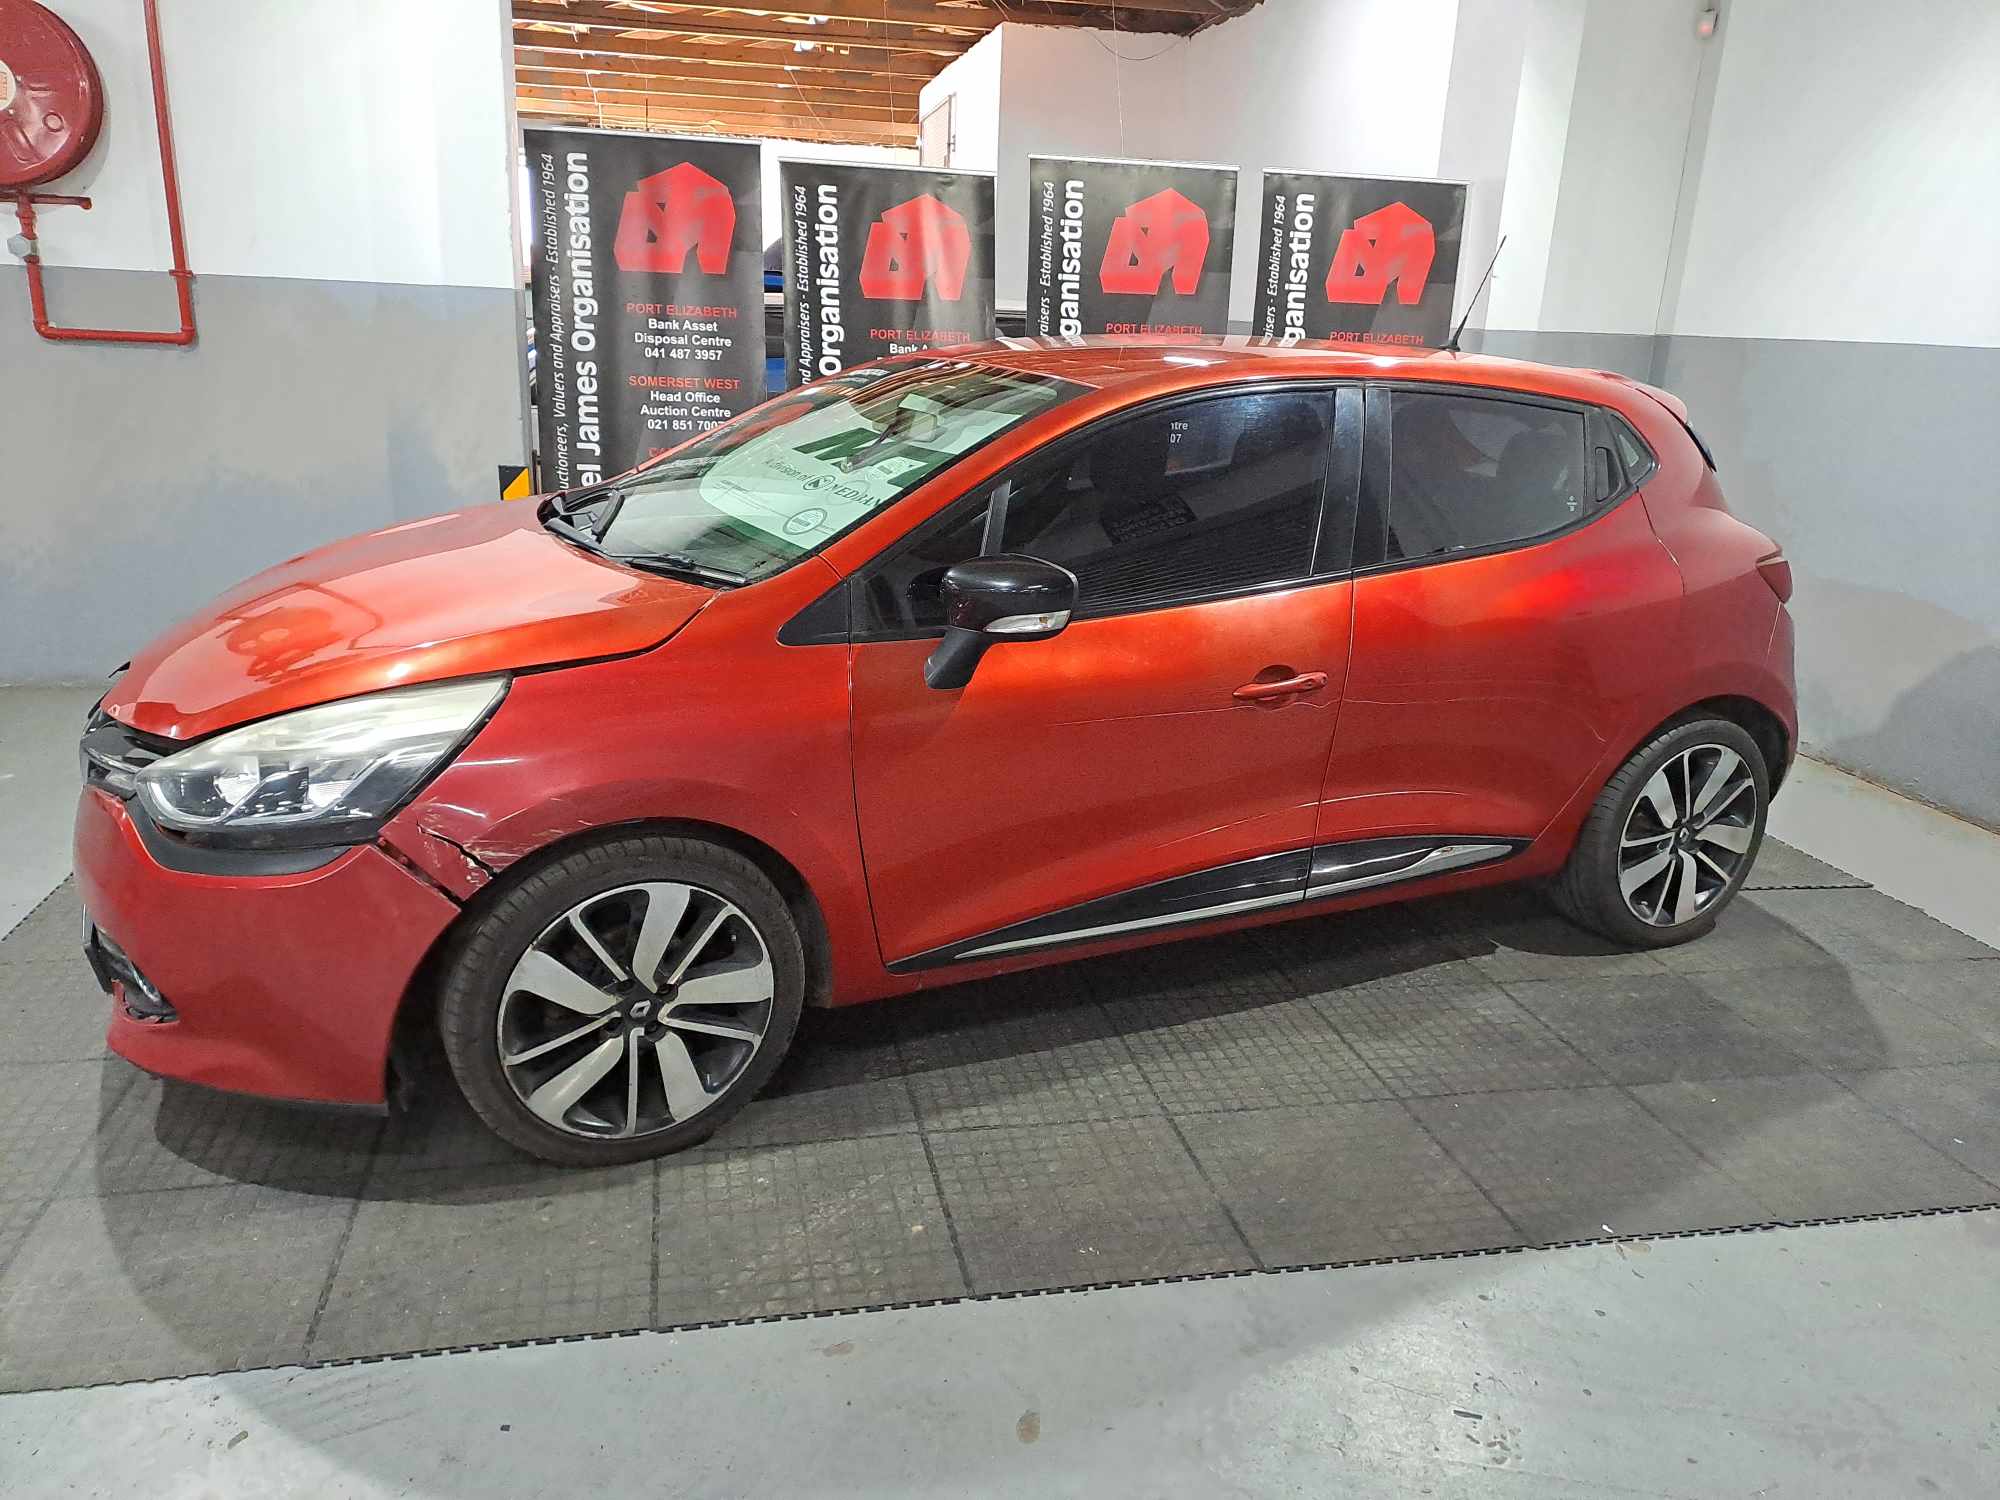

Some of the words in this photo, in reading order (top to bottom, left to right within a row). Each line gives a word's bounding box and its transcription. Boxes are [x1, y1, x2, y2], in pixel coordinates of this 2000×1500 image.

[541, 153, 555, 186] 1964
[794, 185, 808, 216] 1964
[1041, 181, 1056, 213] 1964
[1273, 194, 1287, 226] 1964
[542, 189, 559, 264] Established
[564, 152, 599, 352] Organisation
[794, 218, 809, 292] Established
[1039, 215, 1054, 287] Established
[1266, 227, 1284, 296] Established
[815, 184, 845, 376] Organisation
[547, 274, 565, 342] Appraisers
[626, 302, 662, 315] PORT
[666, 304, 737, 319] ELIZABETH
[634, 332, 688, 346] Disposal
[692, 334, 732, 347] Centre
[648, 318, 680, 330] Bank
[682, 319, 718, 332] Asset
[799, 301, 814, 368] Appraisers
[869, 328, 903, 340] PORT
[1105, 322, 1137, 334] PORT
[1329, 331, 1361, 342] PORT
[1363, 332, 1425, 345] ELIZABETH
[549, 344, 564, 368] and
[644, 347, 665, 358] 041
[669, 348, 691, 360] 487
[694, 349, 722, 361] 3957
[889, 342, 918, 354] Bank
[552, 371, 566, 418] Valuers
[628, 375, 701, 388] SOMERSET
[704, 377, 741, 390] WEST
[650, 390, 681, 402] Head
[685, 391, 721, 404] Office
[576, 361, 601, 457] James
[640, 404, 688, 416] Auction
[691, 406, 731, 418] Centre
[647, 419, 668, 430] 021
[672, 419, 693, 431] 851
